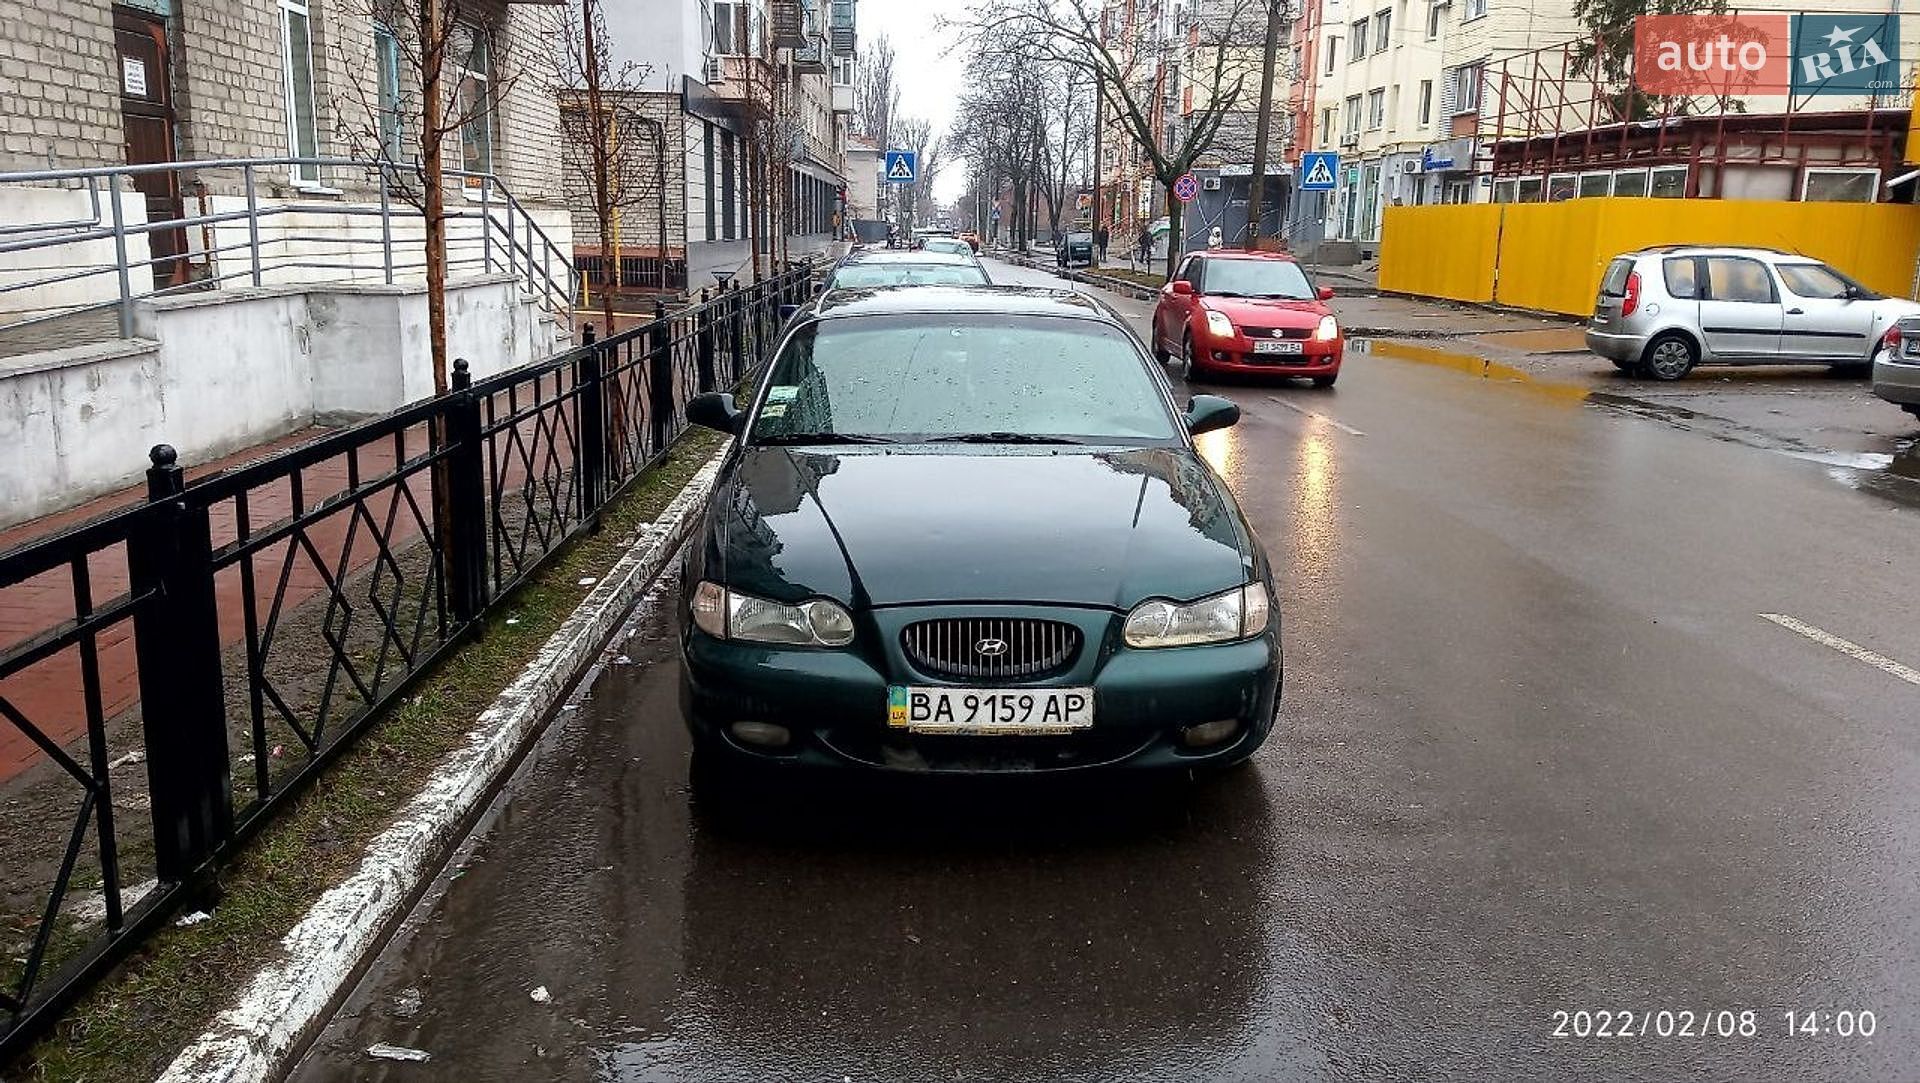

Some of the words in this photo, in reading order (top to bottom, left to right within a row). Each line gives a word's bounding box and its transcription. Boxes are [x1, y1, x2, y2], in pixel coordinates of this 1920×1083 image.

[910, 694, 954, 721] BA
[964, 695, 1034, 722] 9159
[1042, 695, 1085, 722] AP
